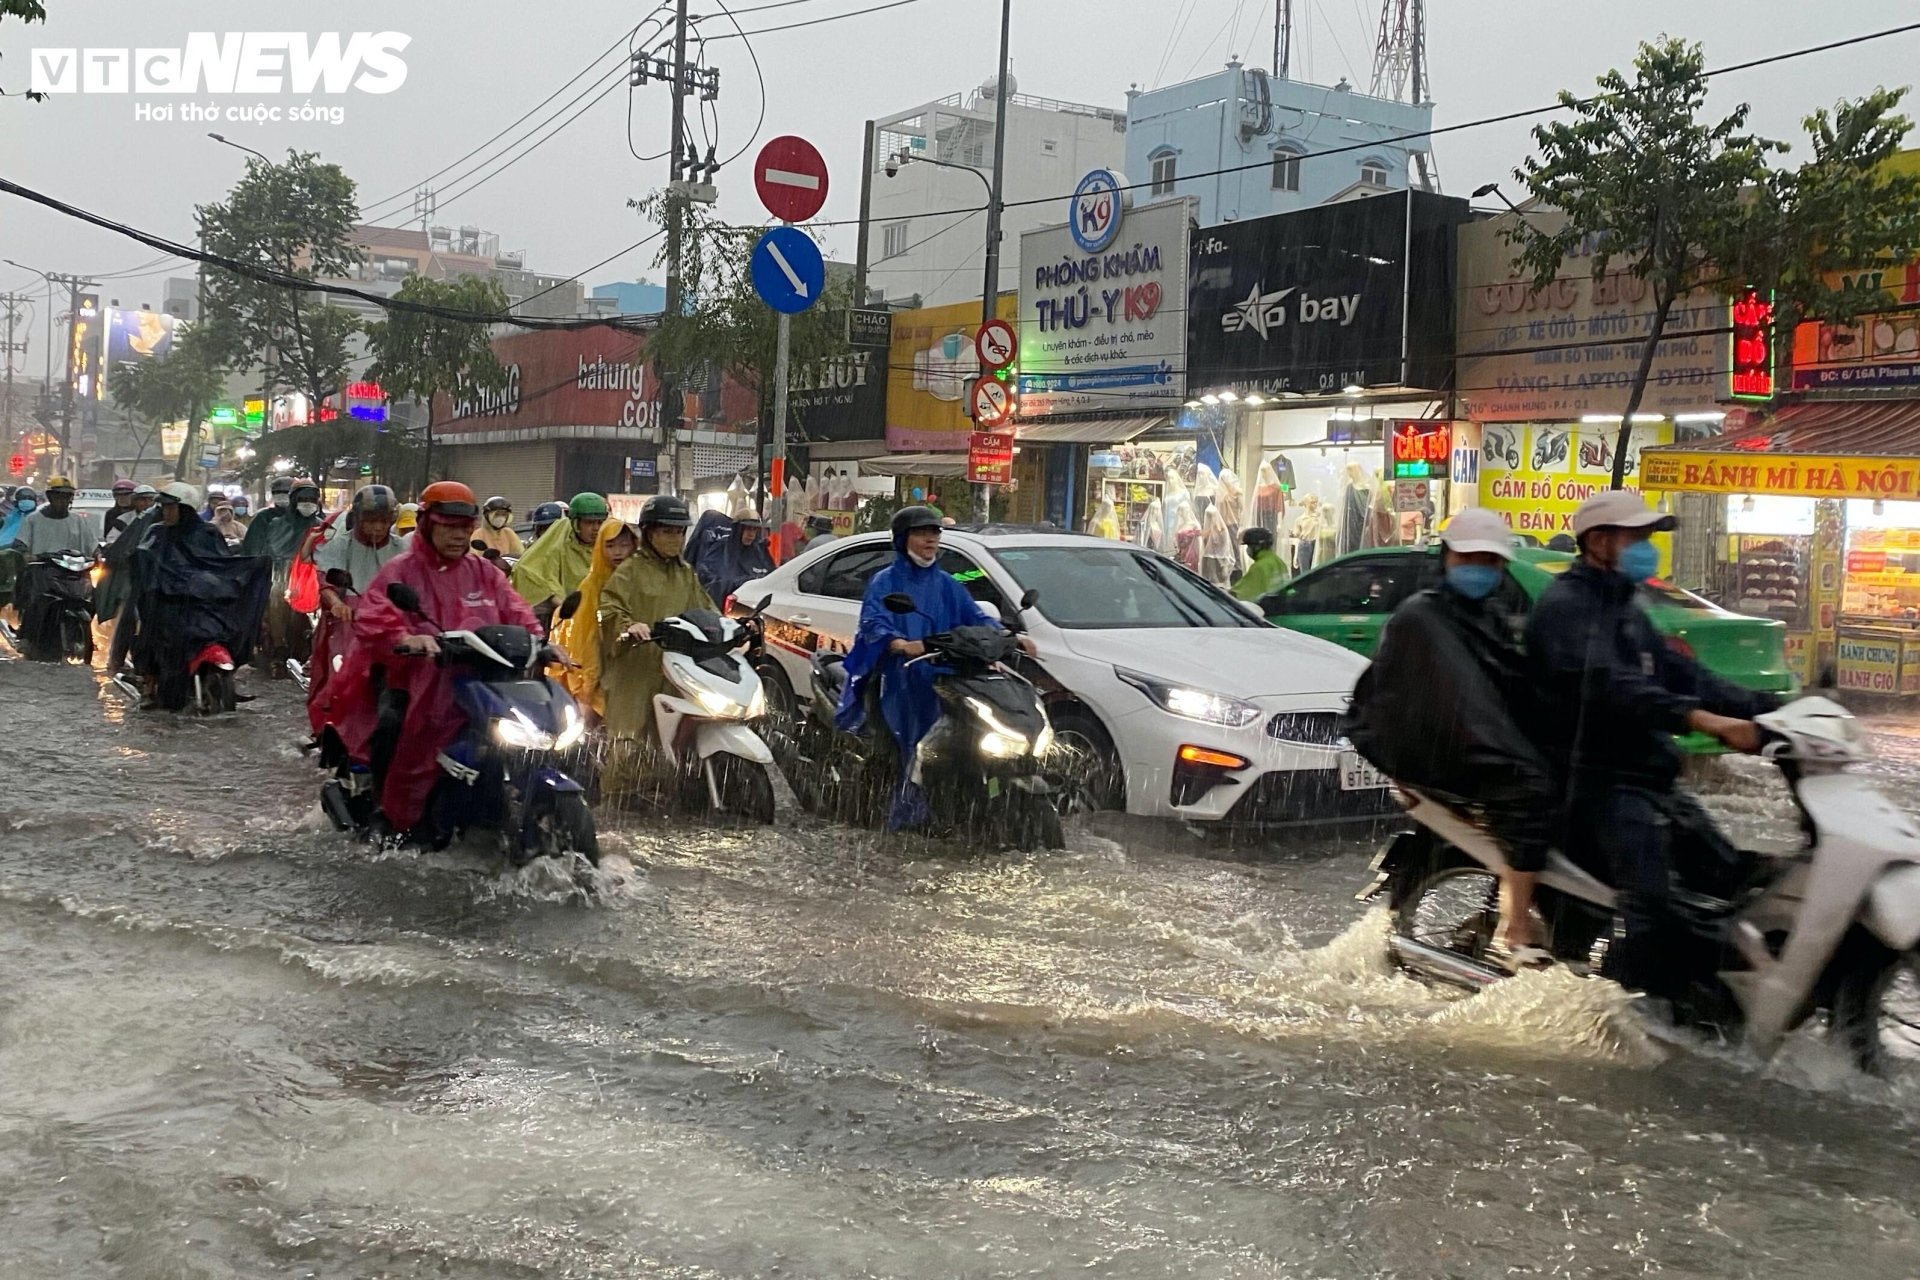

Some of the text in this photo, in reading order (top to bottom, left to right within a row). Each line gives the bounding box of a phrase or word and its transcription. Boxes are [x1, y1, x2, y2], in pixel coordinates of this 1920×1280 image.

[1035, 243, 1163, 290] PHÒNG KHÁM
[1123, 280, 1163, 322] K9
[1299, 292, 1362, 327] bay
[855, 313, 887, 325] CHÁO
[1528, 319, 1546, 340] XE
[1550, 312, 1577, 339] ÔTÔ
[1588, 309, 1628, 337] MÔTÔ
[577, 354, 644, 400] bahung
[1820, 370, 1839, 381] ĐC:
[1841, 368, 1876, 380] 6/16A
[1879, 367, 1910, 379] Phạm
[1492, 472, 1526, 499] CẦM
[1530, 474, 1552, 499] ĐỒ
[1557, 481, 1595, 501] CÔNG
[1683, 459, 1913, 498] BÁNH MÌ HÀ NỘI
[1520, 508, 1556, 530] BÁN
